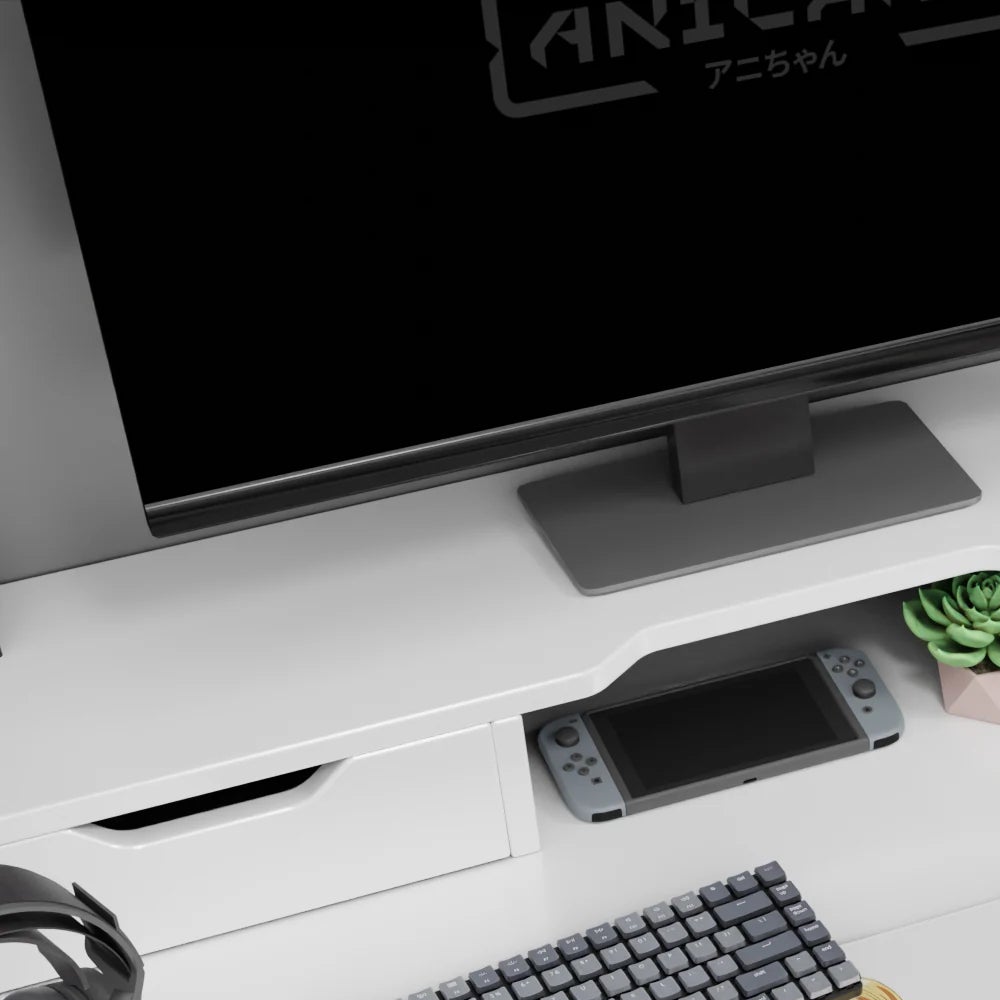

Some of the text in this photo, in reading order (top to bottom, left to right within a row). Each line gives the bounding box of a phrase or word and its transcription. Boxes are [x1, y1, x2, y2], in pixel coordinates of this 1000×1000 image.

[704, 39, 848, 90] アニちゃん
